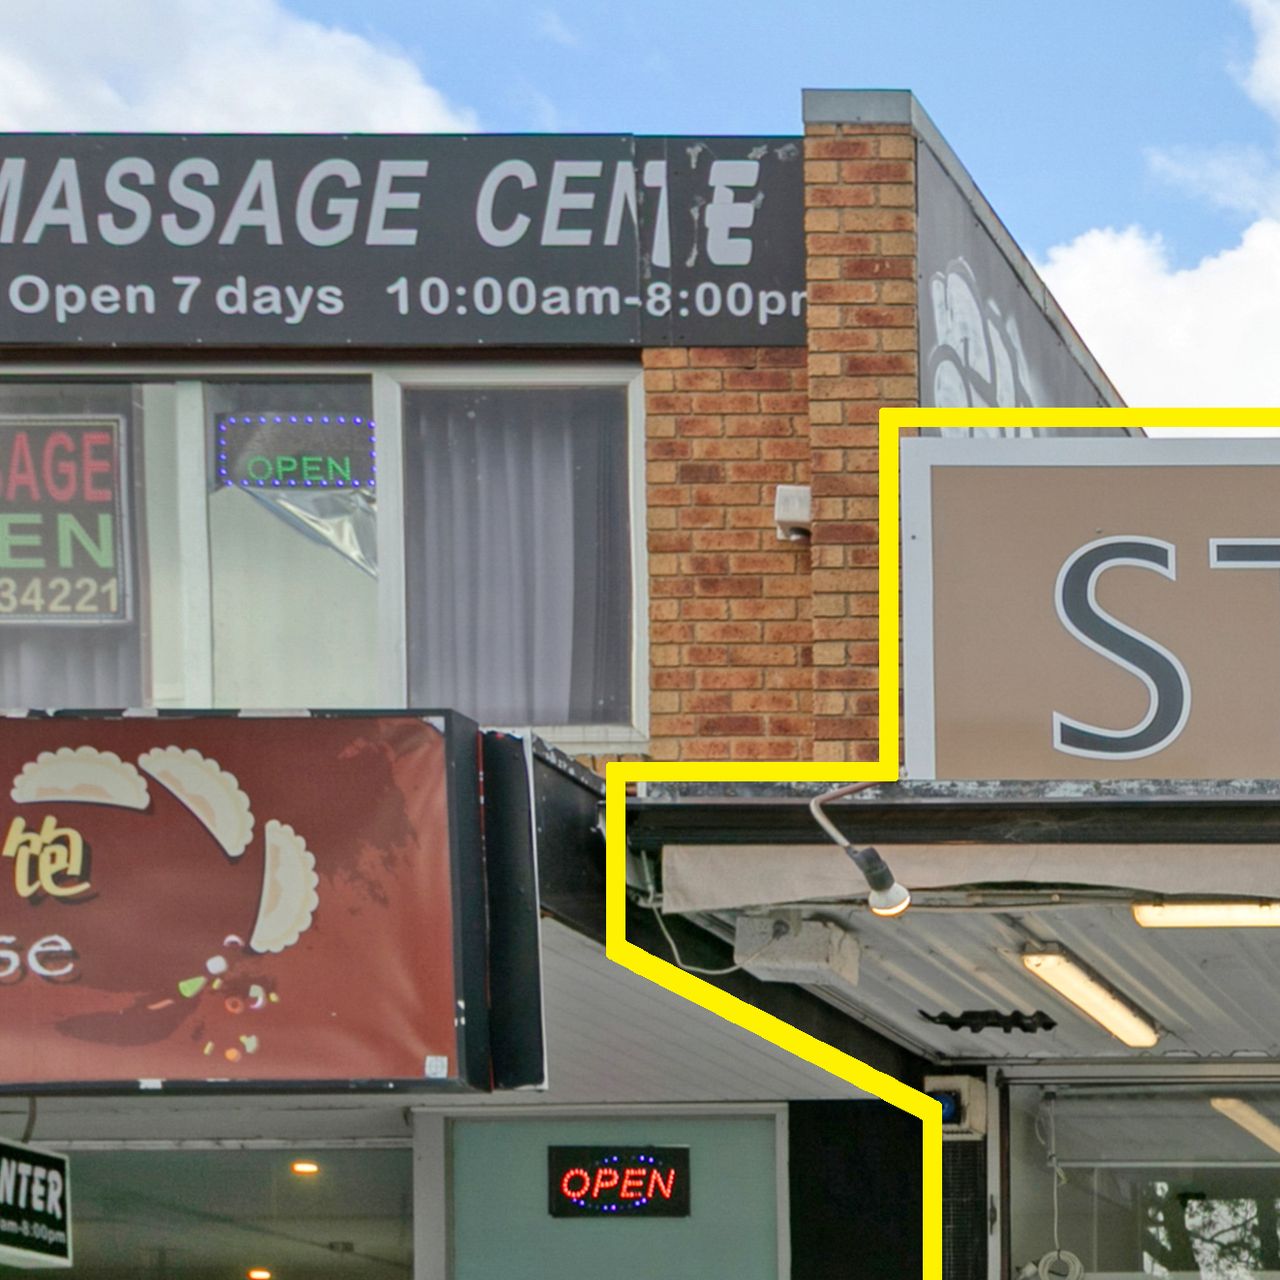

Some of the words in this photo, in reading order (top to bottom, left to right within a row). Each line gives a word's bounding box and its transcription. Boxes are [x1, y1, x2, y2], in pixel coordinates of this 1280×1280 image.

[8, 274, 156, 323] Open
[172, 275, 202, 315] 7
[215, 274, 345, 324] days
[247, 455, 351, 482] OPEN
[560, 1166, 677, 1201] OPEN
